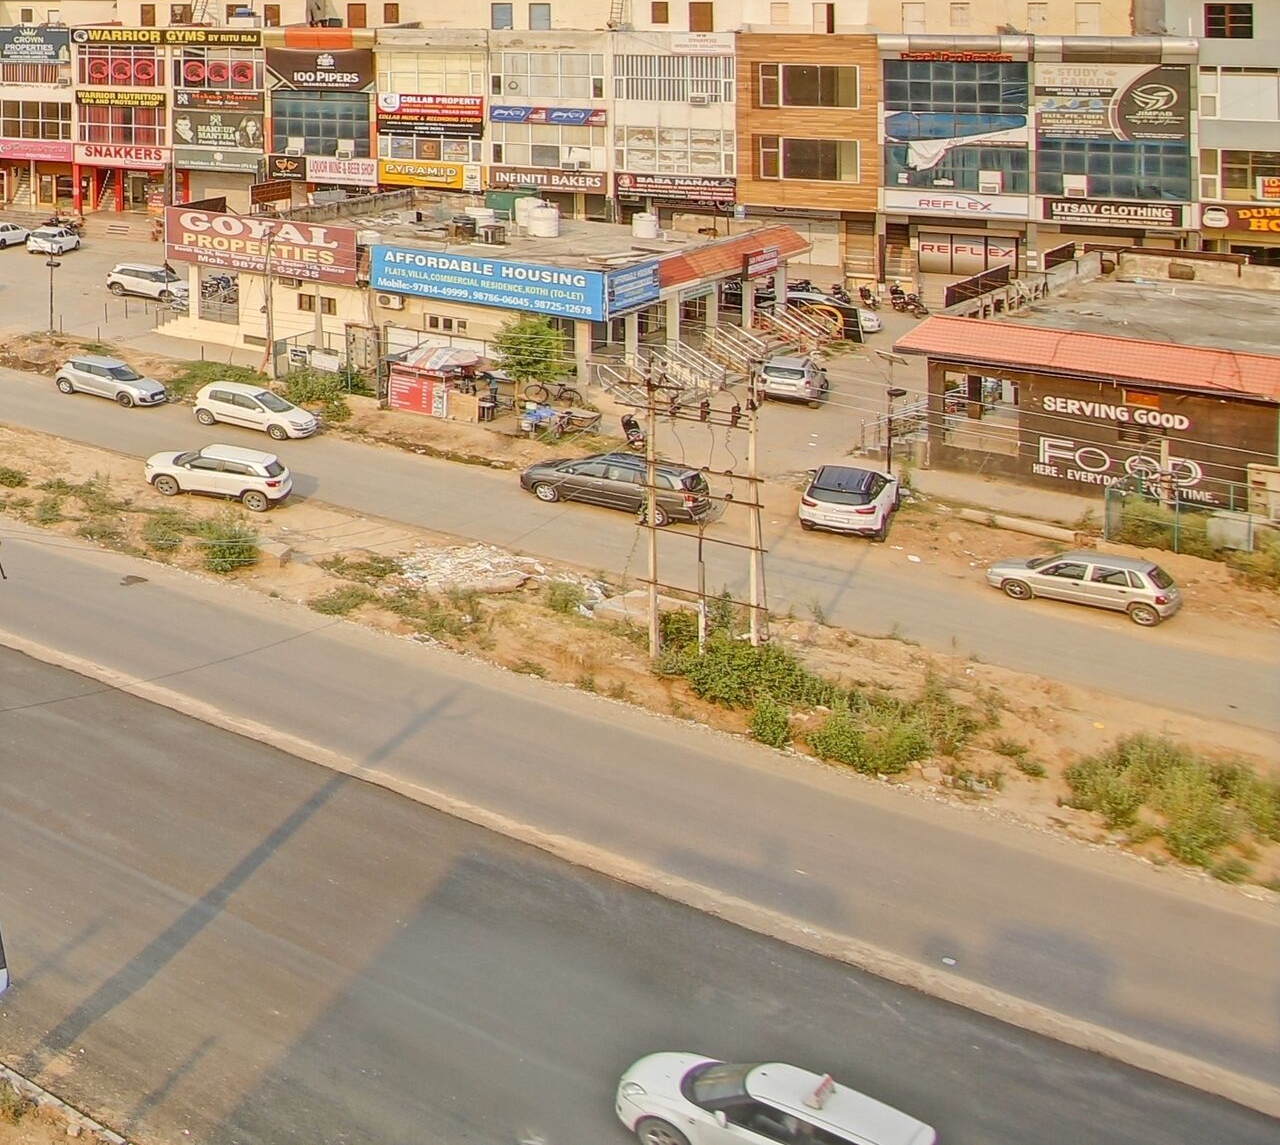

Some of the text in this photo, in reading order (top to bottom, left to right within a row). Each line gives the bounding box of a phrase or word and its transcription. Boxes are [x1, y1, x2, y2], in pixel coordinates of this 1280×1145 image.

[88, 30, 257, 42] WARRIOR GYMS BY RITU RAJ
[4, 43, 54, 51] PROPERTIES
[293, 71, 316, 82] 100
[1057, 68, 1098, 77] STUDY
[1043, 77, 1113, 86] IN CANADA
[77, 91, 164, 101] WARRIOR NUTRITION
[435, 96, 481, 105] PROPERTY
[197, 125, 236, 133] MAKEUP
[197, 132, 236, 140] MANTRA
[84, 146, 163, 161] SNAKKERS
[309, 160, 328, 174] LIQUOR
[347, 162, 360, 174] BEER
[360, 162, 375, 175] SHOP
[385, 164, 457, 176] PYRAMID
[495, 171, 601, 188] INFINITI BAKERS
[636, 176, 720, 187] BABA NANAK
[918, 199, 993, 211] REFLEX
[1052, 202, 1173, 218] UTSAV CLOTHING
[179, 211, 339, 249] GOYAL
[182, 232, 335, 265] PROPERTIES
[921, 244, 1014, 257] REFLEX
[197, 255, 320, 279] Mob. 9876-62735
[384, 251, 586, 288] AFFORDABLE HOUSING
[550, 289, 584, 302] (TO-LET)
[534, 299, 593, 315] 98725-12678
[1042, 396, 1191, 431] SERVING GOOD
